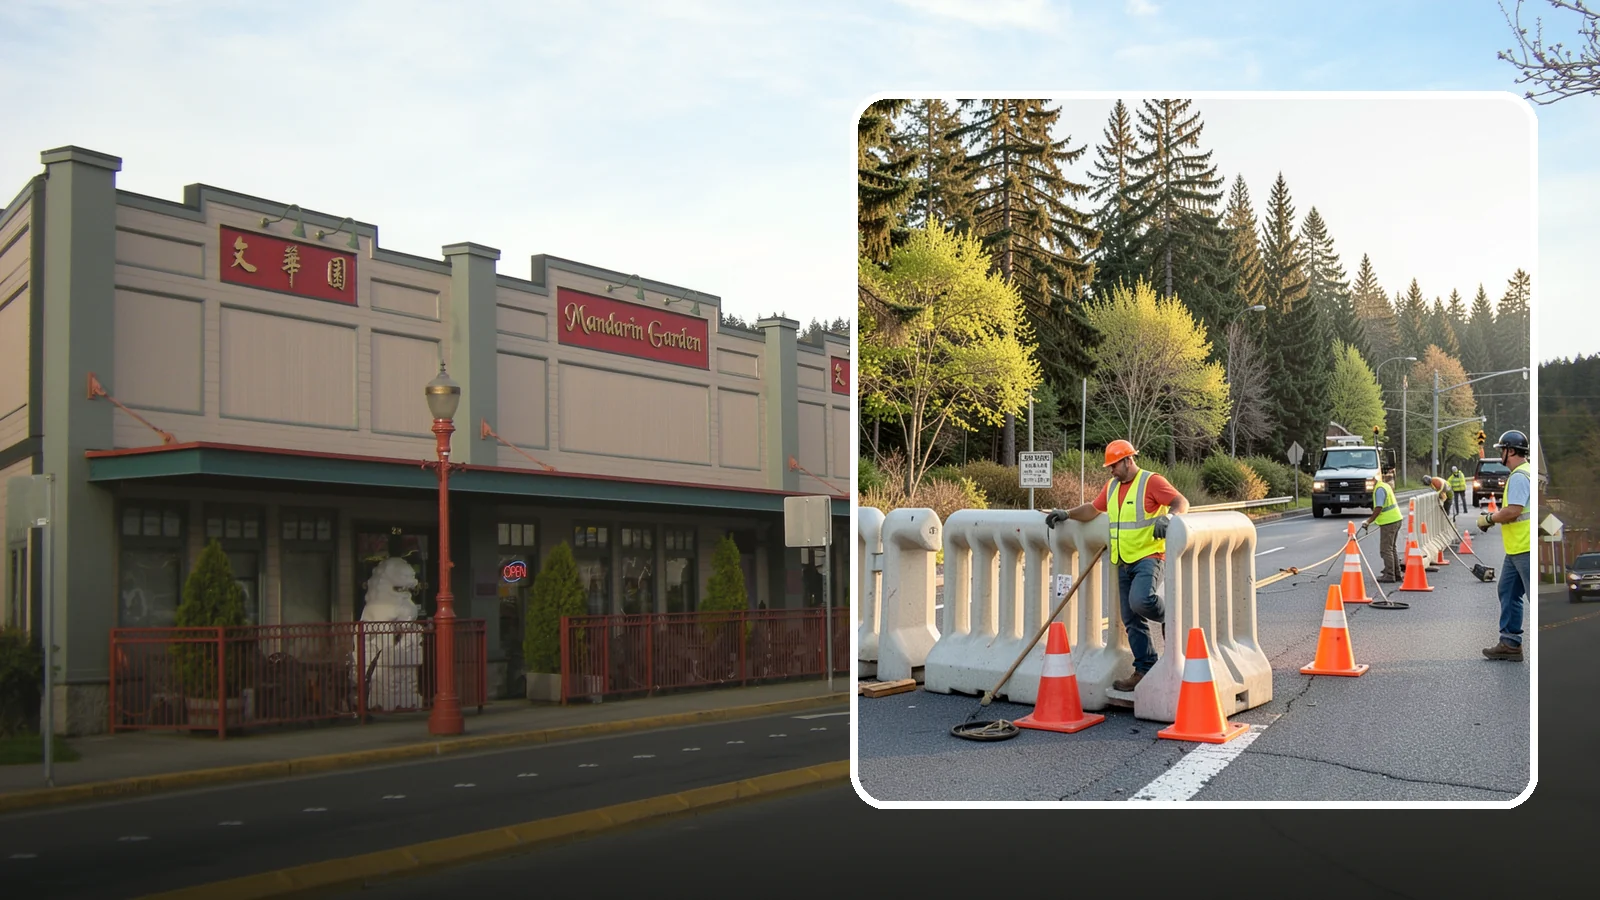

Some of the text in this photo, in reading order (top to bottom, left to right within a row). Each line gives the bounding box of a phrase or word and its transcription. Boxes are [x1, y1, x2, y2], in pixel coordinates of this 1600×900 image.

[230, 235, 347, 291] 文華園
[564, 302, 701, 352] Mandarin Garden
[503, 565, 527, 578] OPEN
